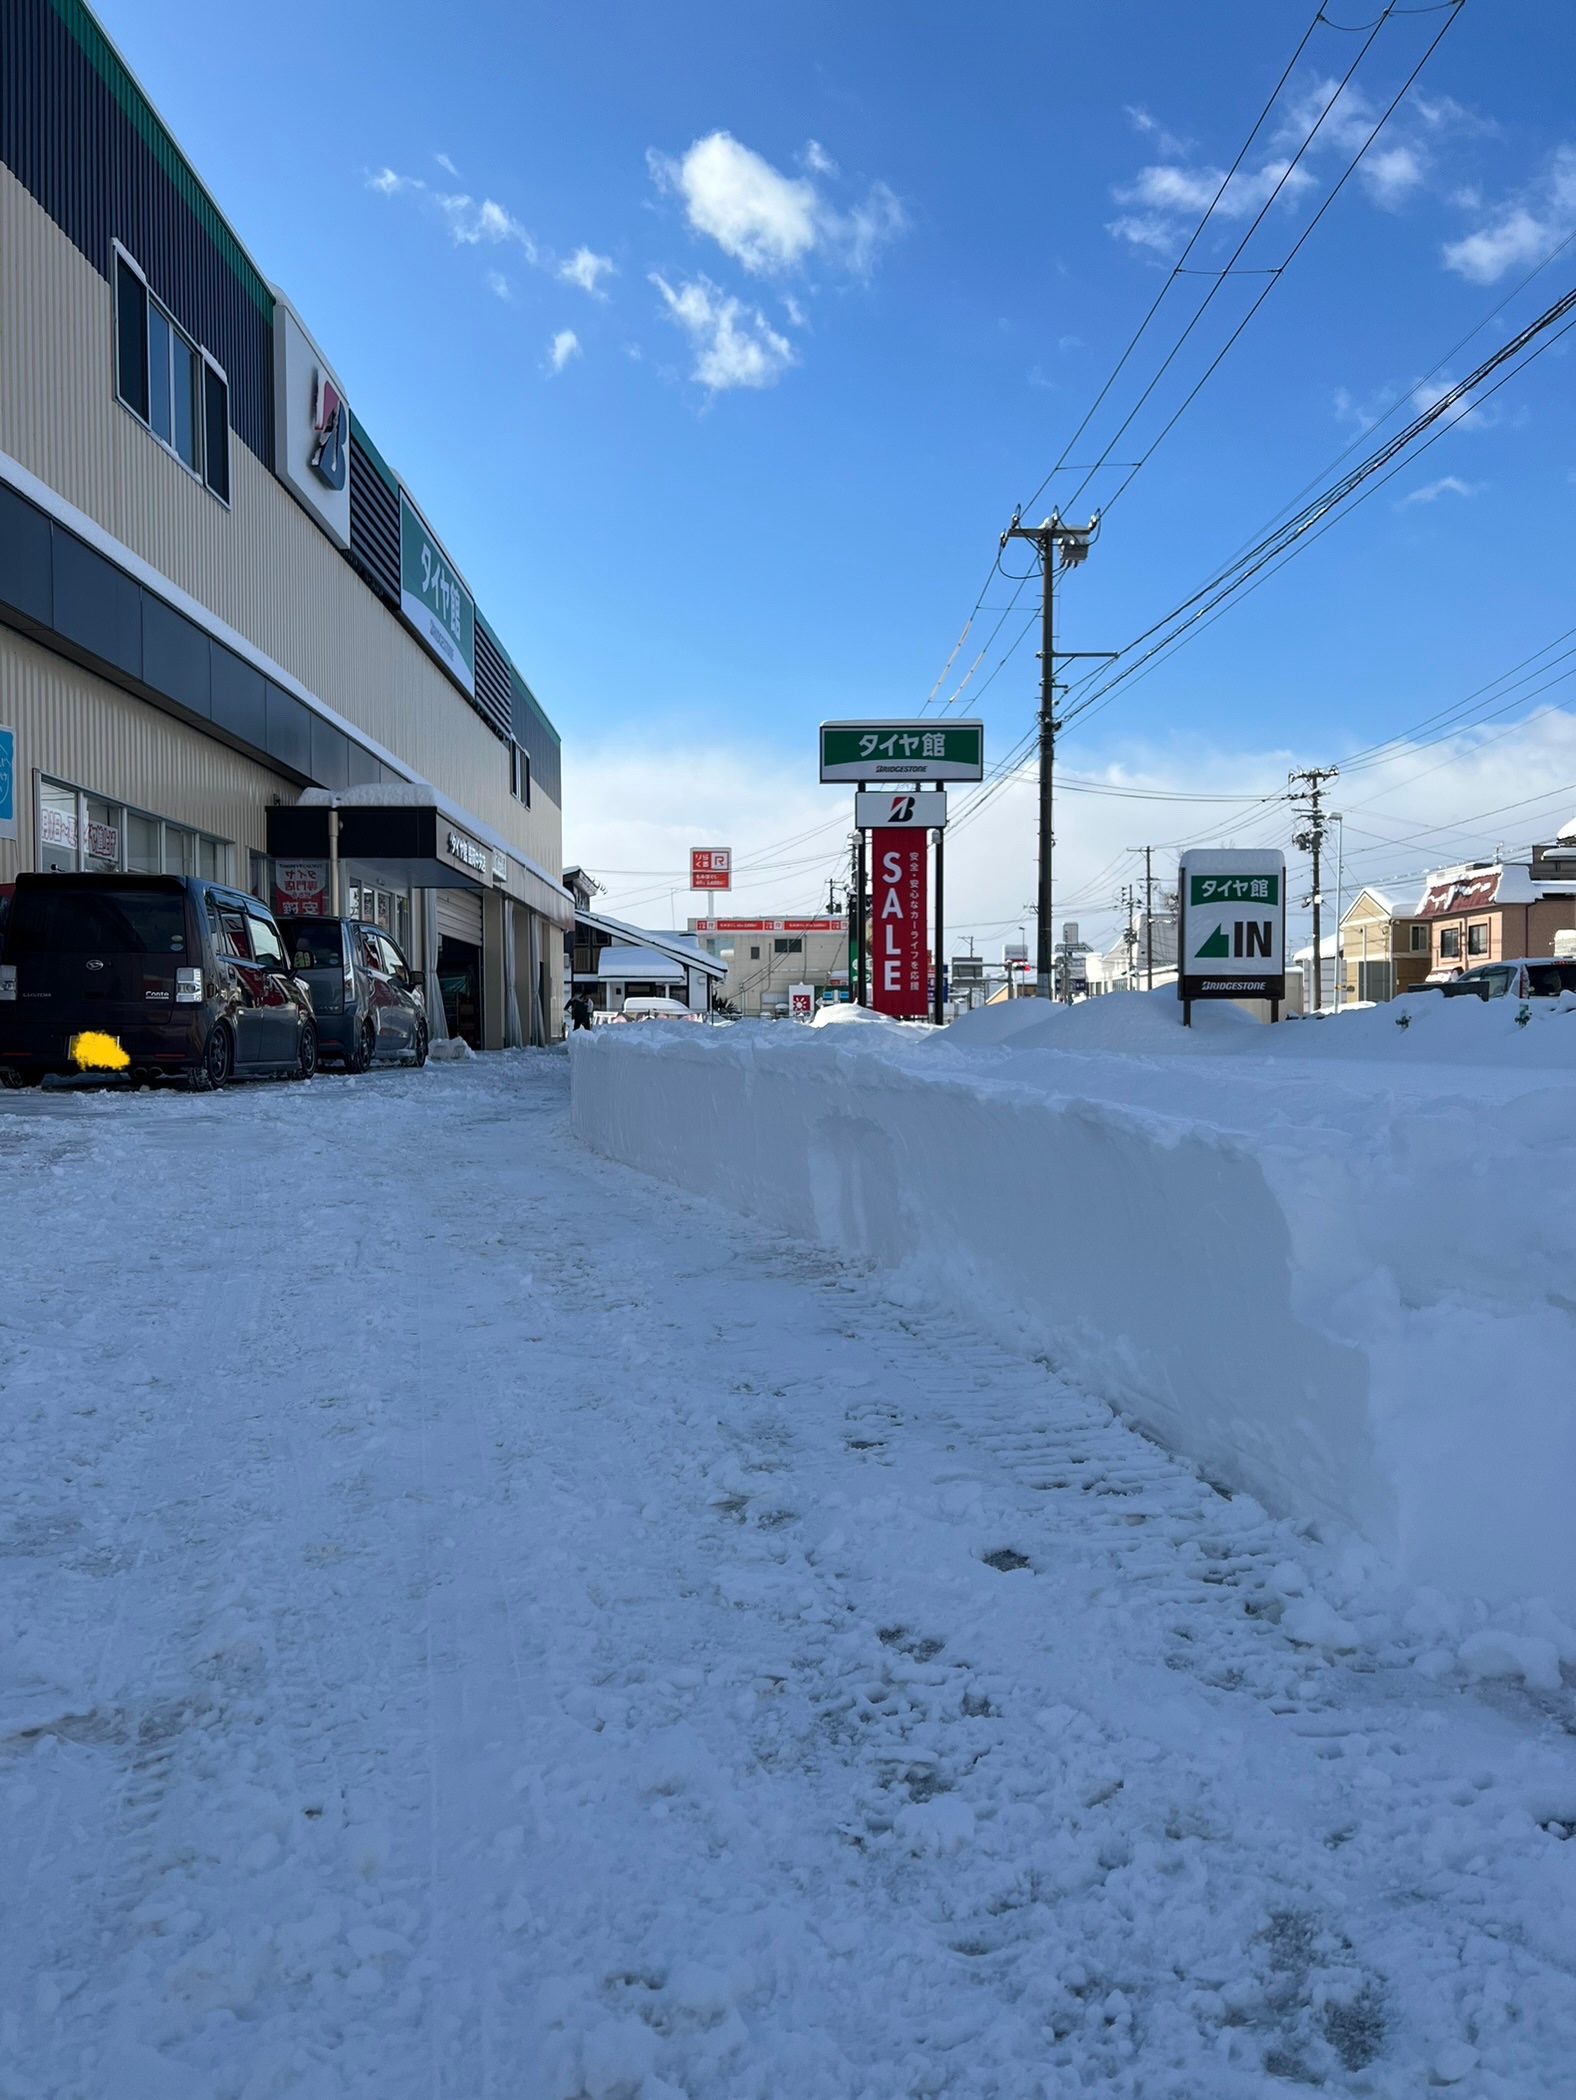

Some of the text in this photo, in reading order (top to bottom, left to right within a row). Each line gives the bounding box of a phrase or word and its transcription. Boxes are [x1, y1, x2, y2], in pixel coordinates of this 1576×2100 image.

[421, 541, 461, 641] タイヤ館
[858, 732, 946, 757] タイヤ館
[875, 765, 928, 773] BRIDGESTONE
[714, 856, 725, 866] R
[1201, 878, 1269, 898] タイヤ館
[881, 851, 904, 992] SALE
[1233, 921, 1272, 958] IN
[145, 990, 170, 998] Conte
[1200, 981, 1267, 991] BRIDGESTONE
